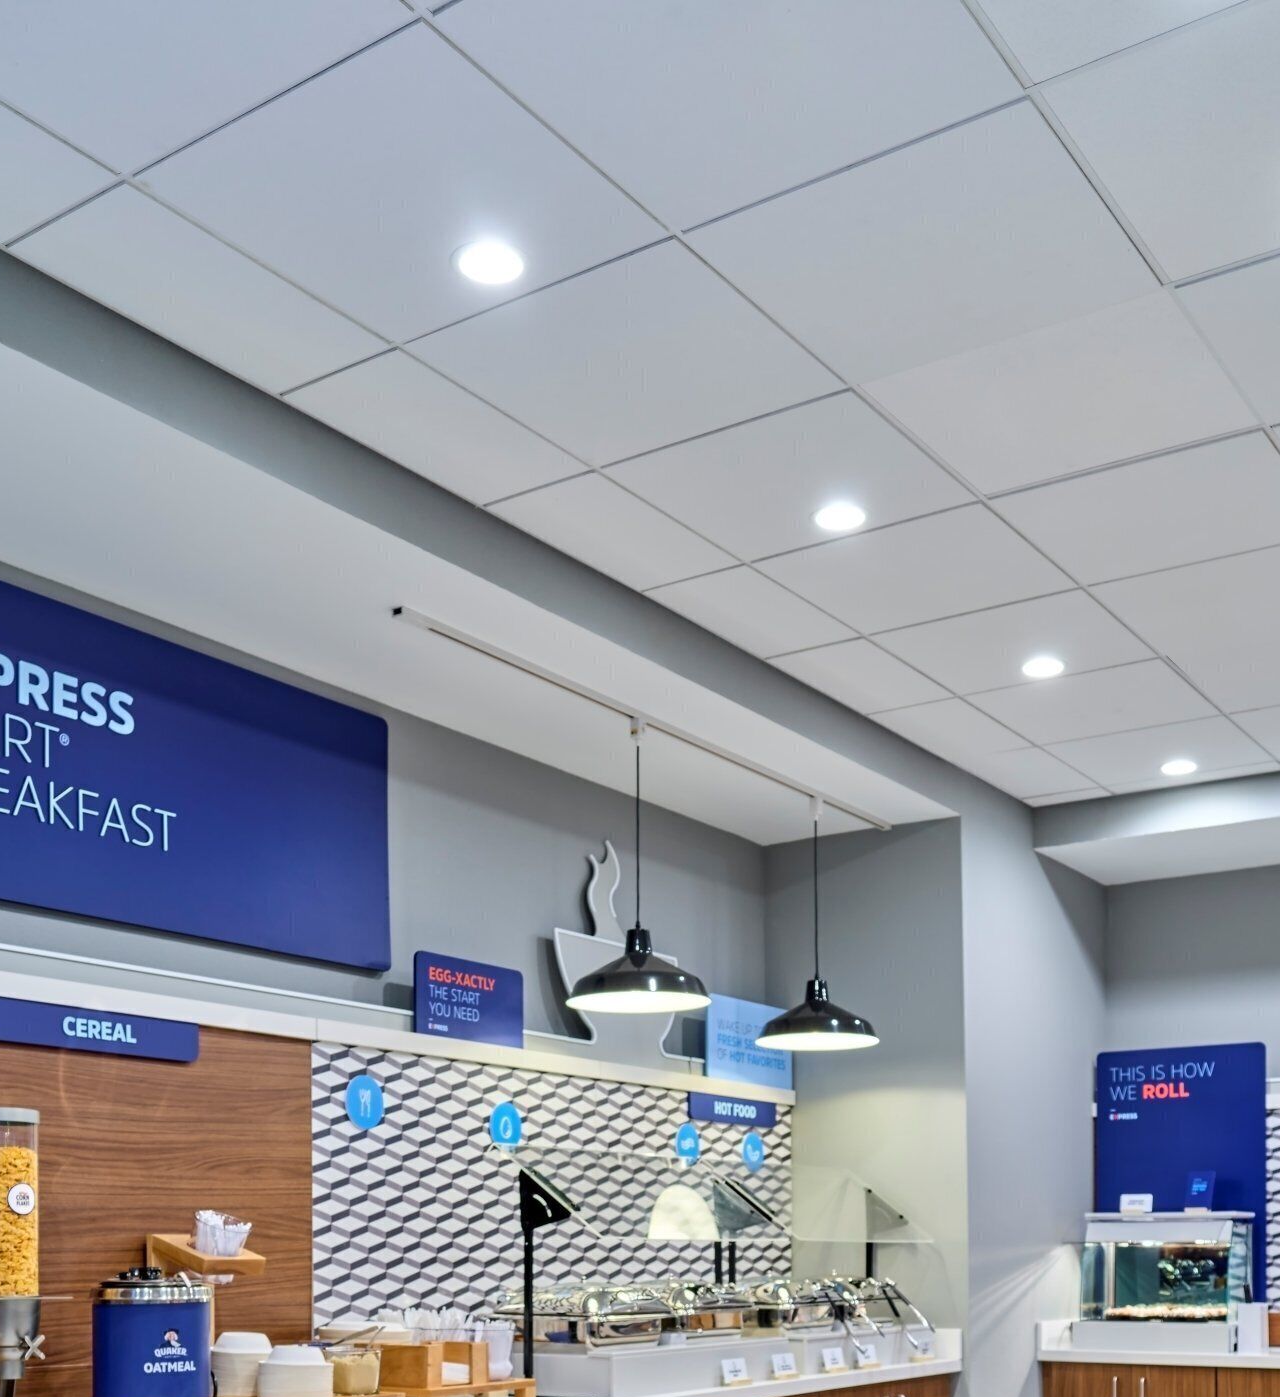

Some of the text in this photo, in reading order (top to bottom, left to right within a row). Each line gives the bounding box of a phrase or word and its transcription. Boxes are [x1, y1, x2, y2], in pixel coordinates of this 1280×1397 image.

[428, 966, 496, 991] EGG-XACTLY
[428, 984, 481, 1006] THE START
[428, 1001, 480, 1022] YOU NEED
[62, 1016, 138, 1044] CEREAL
[1109, 1061, 1216, 1083] THIS IS HOW
[1109, 1081, 1190, 1102] WE ROLL
[714, 1101, 757, 1119] HOT FOOD
[154, 1346, 189, 1358] QUAKER
[143, 1360, 197, 1374] OATMEAL
